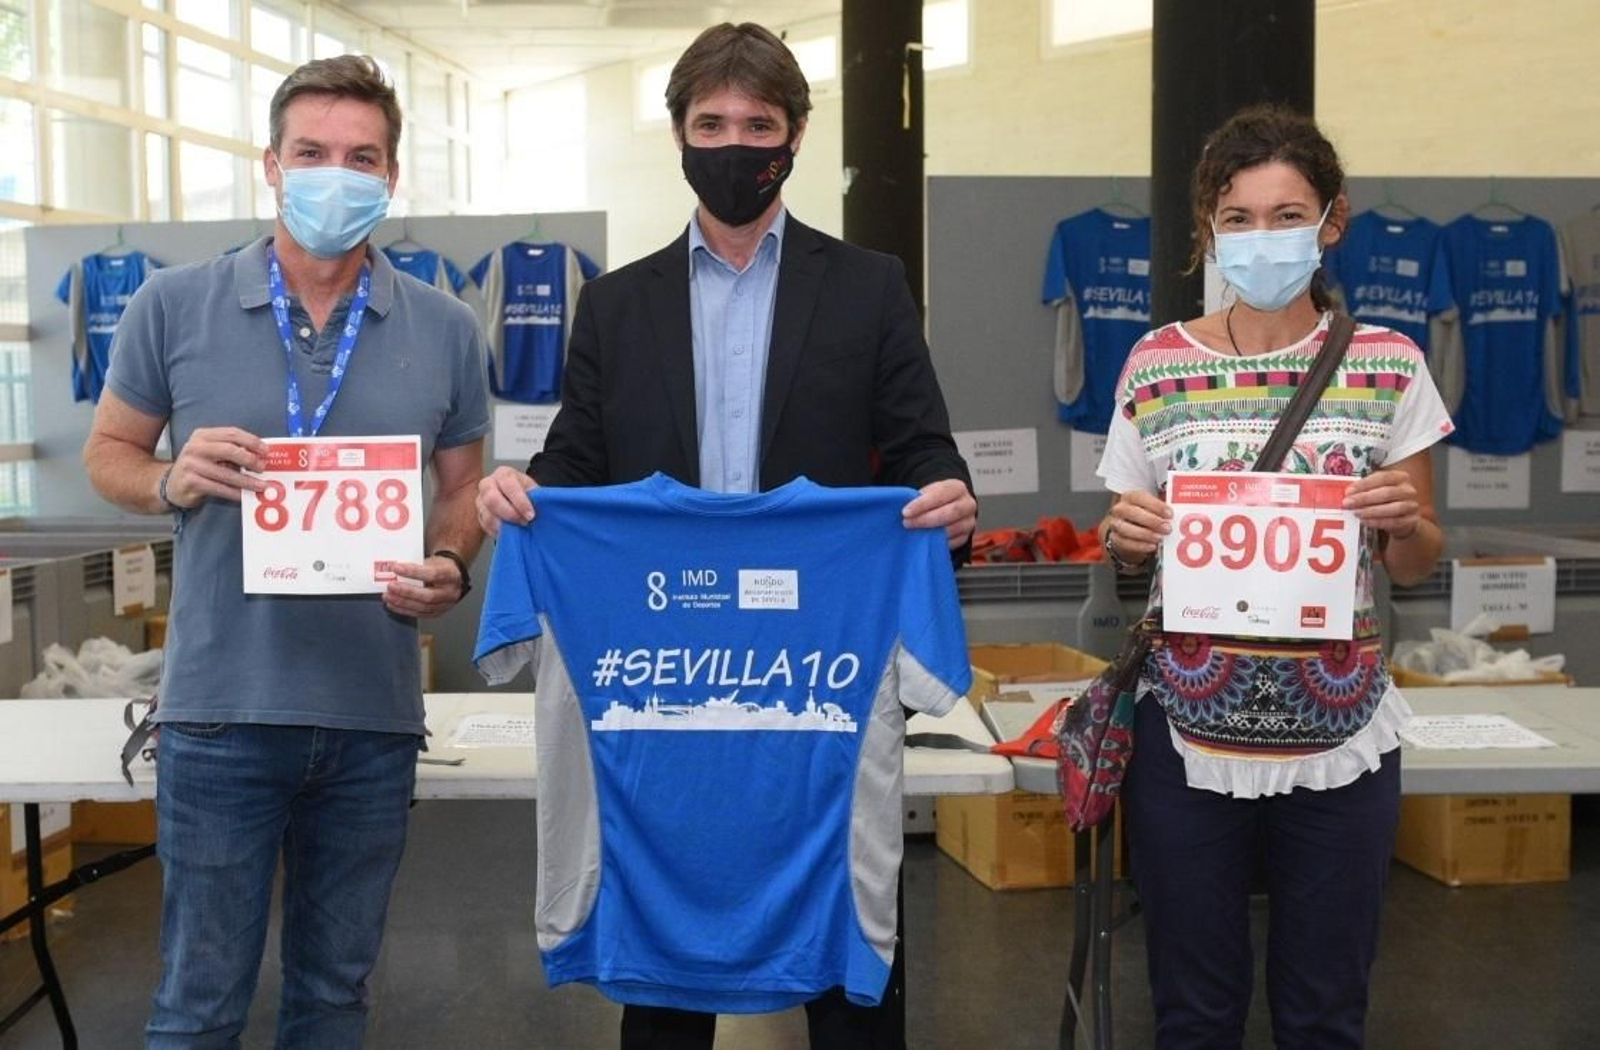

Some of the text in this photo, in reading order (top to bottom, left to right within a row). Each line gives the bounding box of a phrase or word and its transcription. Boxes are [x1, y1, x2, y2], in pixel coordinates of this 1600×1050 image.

[254, 479, 410, 532] 8788
[1176, 513, 1346, 574] 8905
[682, 570, 717, 586] IMD
